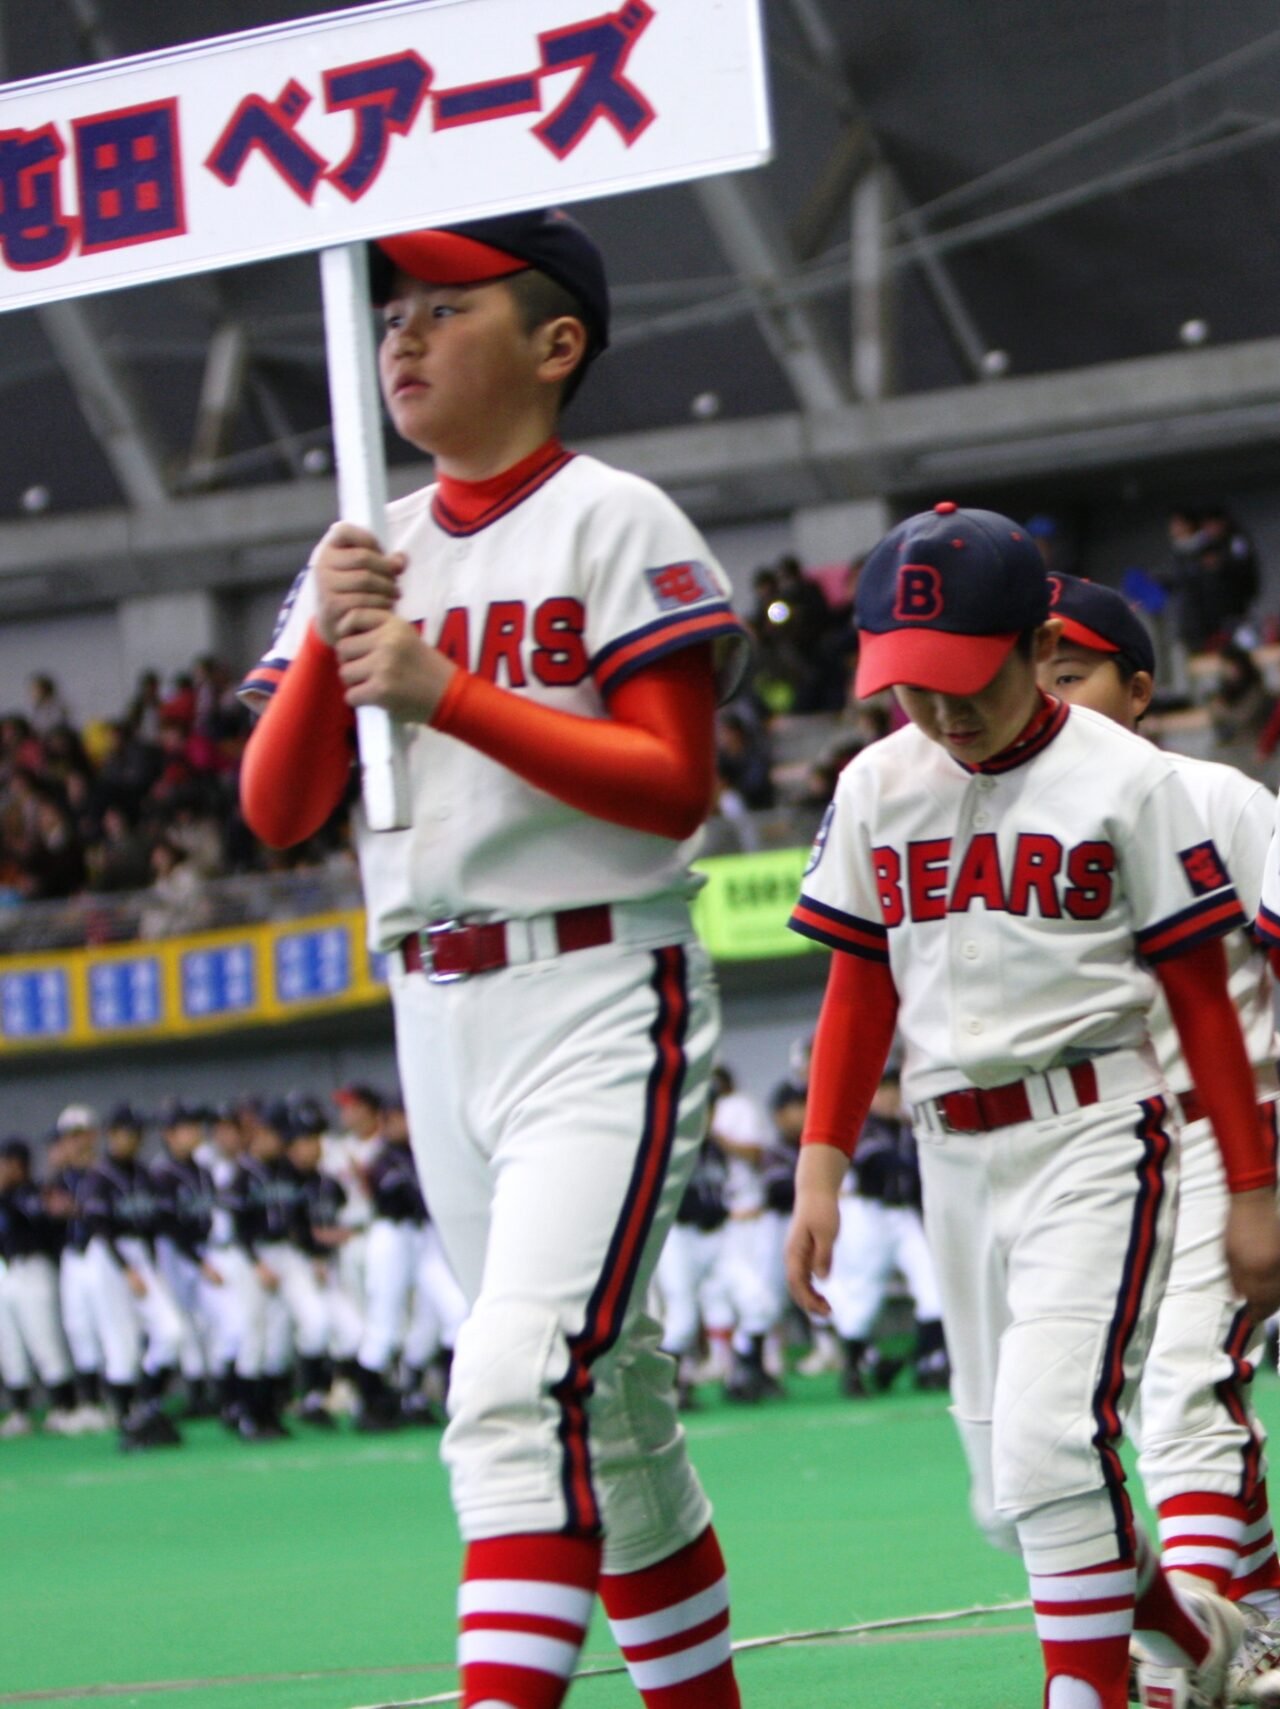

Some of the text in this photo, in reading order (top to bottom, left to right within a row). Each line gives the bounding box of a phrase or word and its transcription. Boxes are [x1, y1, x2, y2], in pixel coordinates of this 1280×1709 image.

[893, 564, 943, 621] B
[410, 597, 590, 687] ARS
[872, 832, 1116, 928] BEARS
